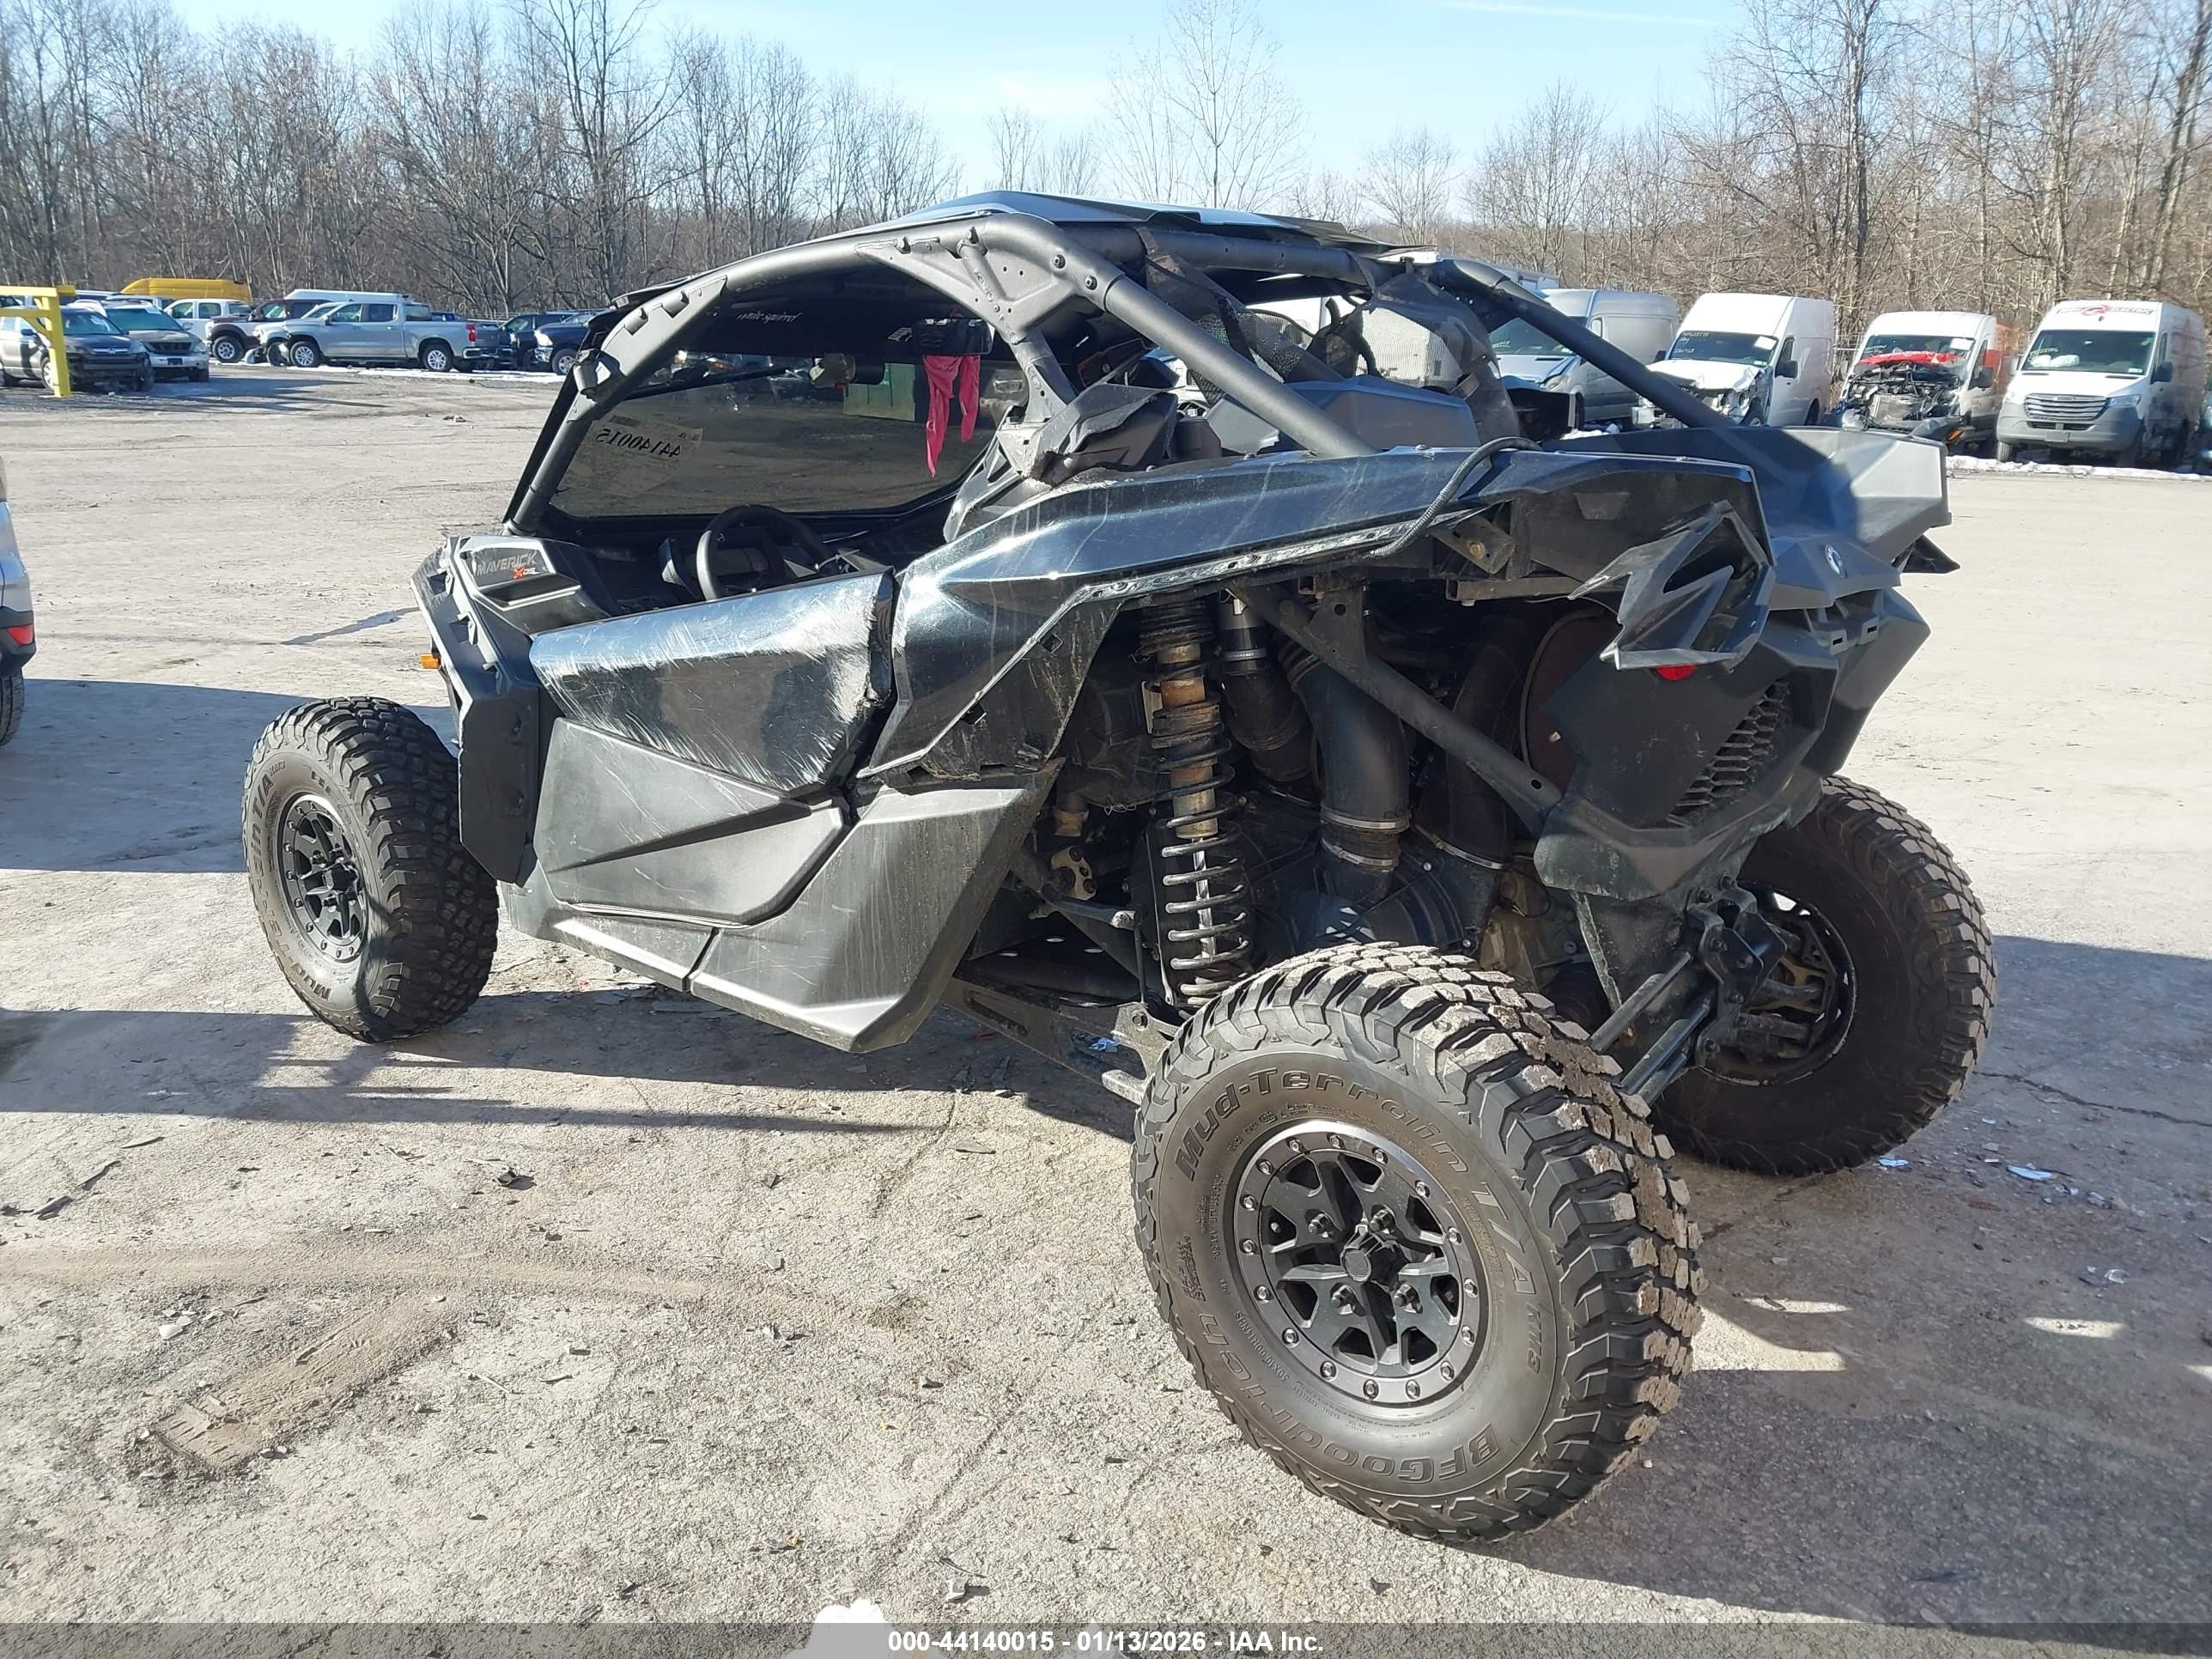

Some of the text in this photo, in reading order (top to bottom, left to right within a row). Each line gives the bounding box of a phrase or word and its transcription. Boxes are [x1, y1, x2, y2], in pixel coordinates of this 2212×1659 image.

[477, 552, 537, 576] MAVERICK
[1176, 1067, 1469, 1182] Mud-Terrain
[1199, 1313, 1501, 1485] BFGoodrich
